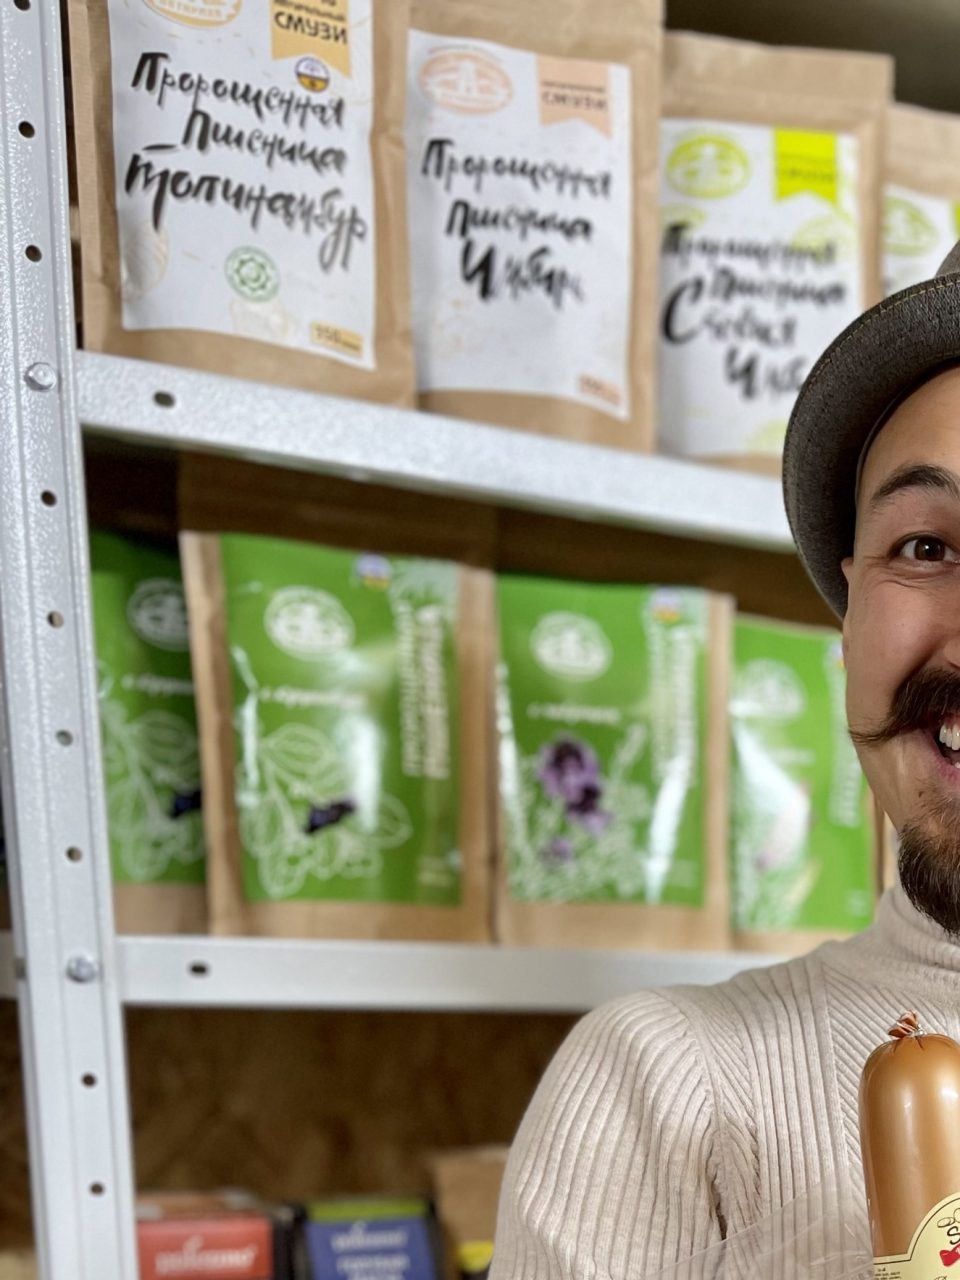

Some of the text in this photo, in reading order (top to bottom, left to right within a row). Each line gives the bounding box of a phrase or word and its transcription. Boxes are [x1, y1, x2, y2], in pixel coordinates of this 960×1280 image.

[274, 11, 348, 44] СМУЗИ
[131, 52, 344, 127] Пророщенная
[182, 109, 347, 173] Пшеница
